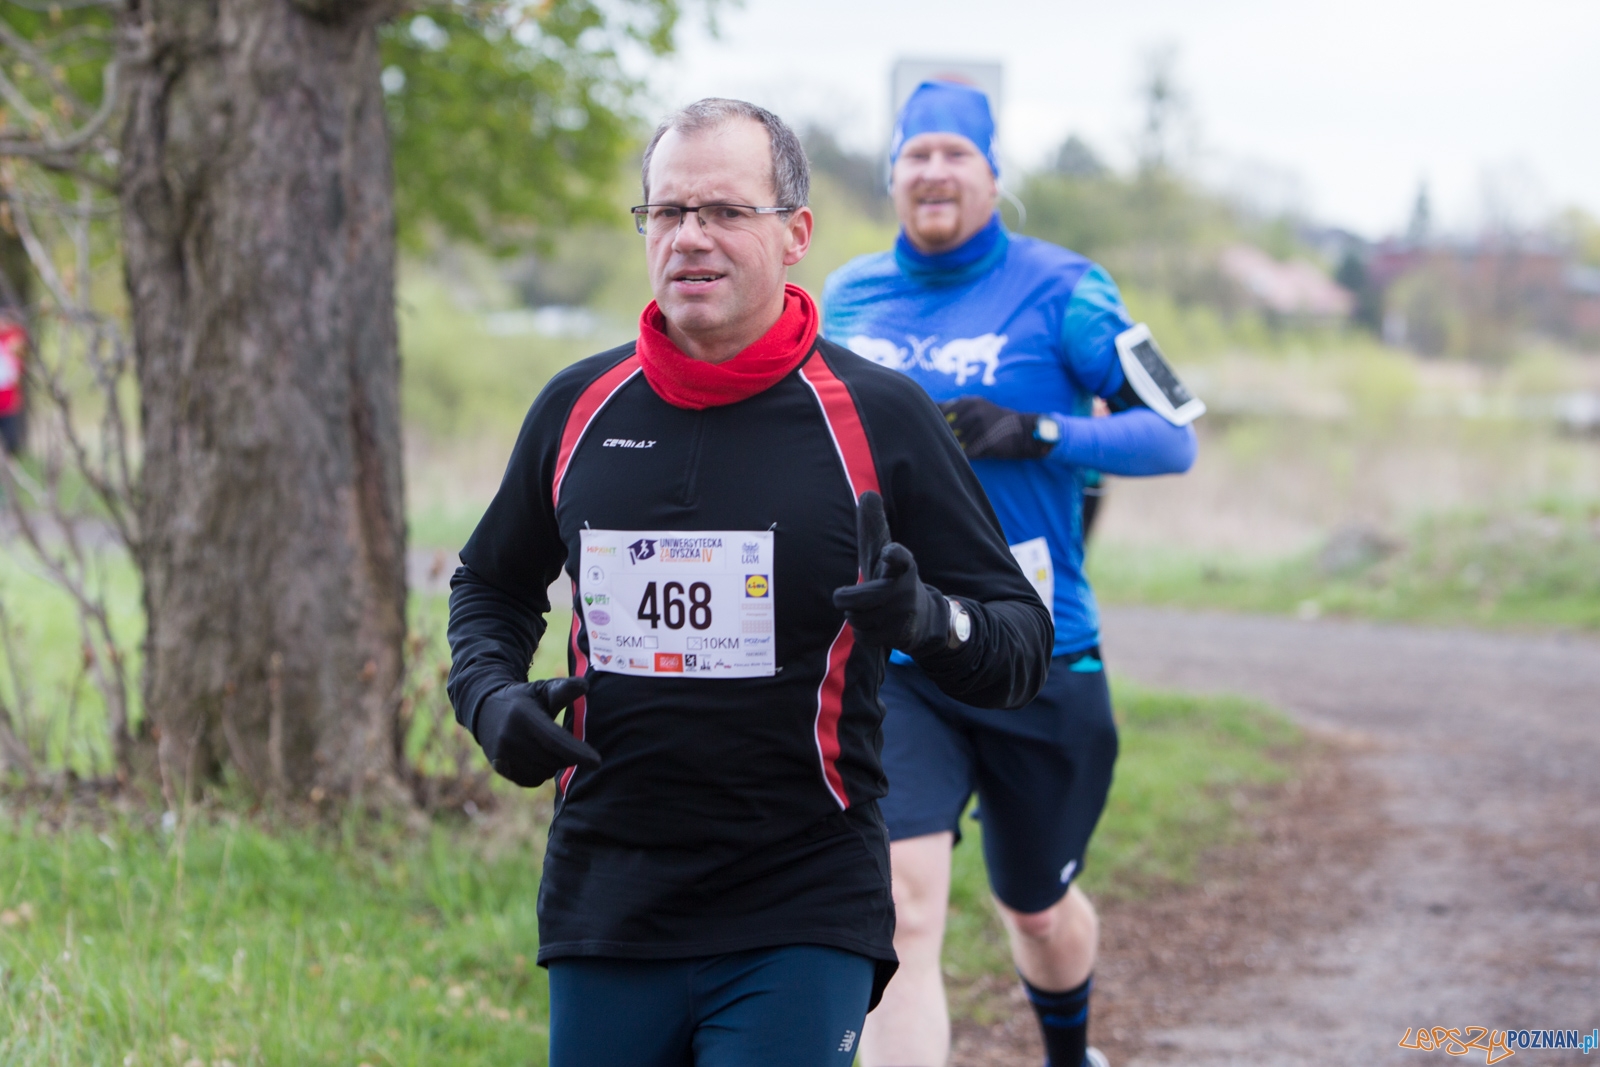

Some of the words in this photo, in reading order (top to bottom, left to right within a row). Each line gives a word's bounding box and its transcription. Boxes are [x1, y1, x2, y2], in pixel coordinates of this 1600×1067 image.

[660, 538, 722, 548] UNIWERSYTECKA
[660, 548, 700, 558] ZADYSZKA
[702, 547, 713, 563] IV
[637, 581, 712, 630] 468
[616, 635, 643, 648] 5KM
[703, 637, 740, 650] 10KM
